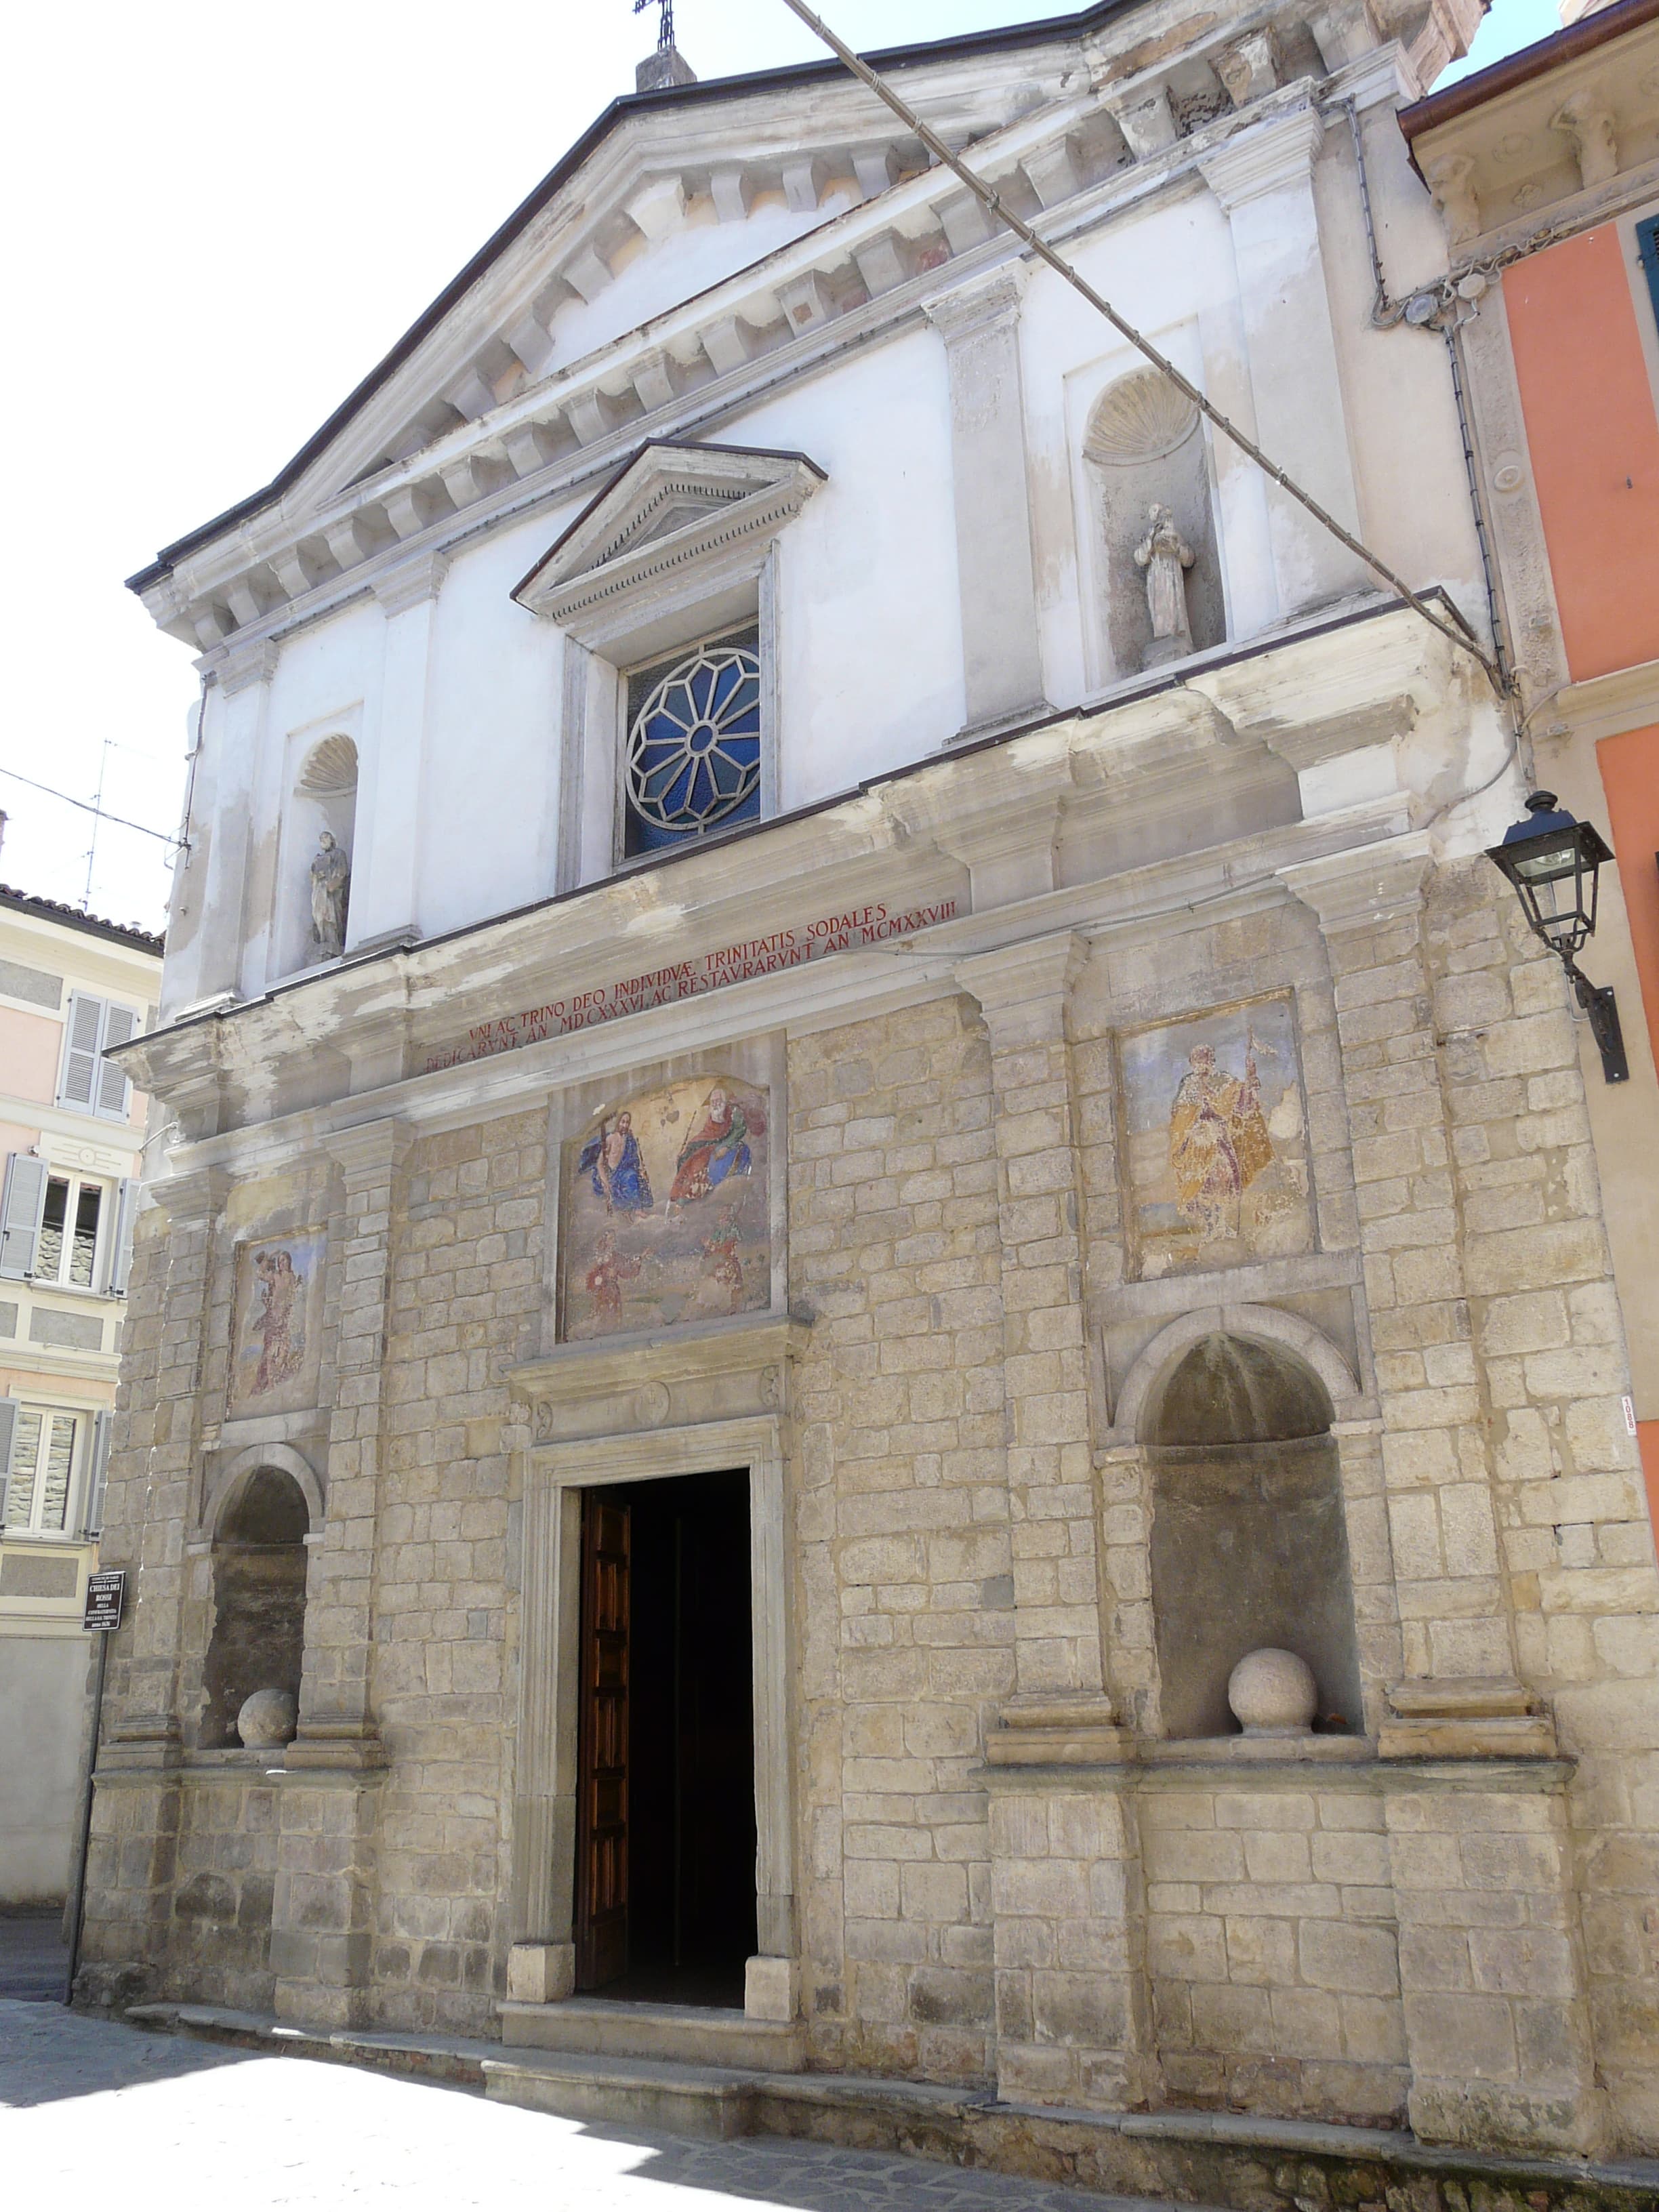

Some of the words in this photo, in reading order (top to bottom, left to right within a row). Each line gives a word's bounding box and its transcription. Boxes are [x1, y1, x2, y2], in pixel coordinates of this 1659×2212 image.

[424, 1031, 518, 1073] DEDICARVNT
[526, 1023, 548, 1044] AN
[560, 994, 644, 1033] MDCXXXVI
[651, 985, 672, 1006] AC
[678, 942, 816, 998] RESTAVRARVNT
[823, 931, 851, 955] AN
[495, 1017, 516, 1035] AC
[520, 1002, 565, 1027] TRINO
[573, 988, 605, 1012] DEO
[705, 930, 796, 970] TRINITATIS
[807, 903, 887, 941] SODALES
